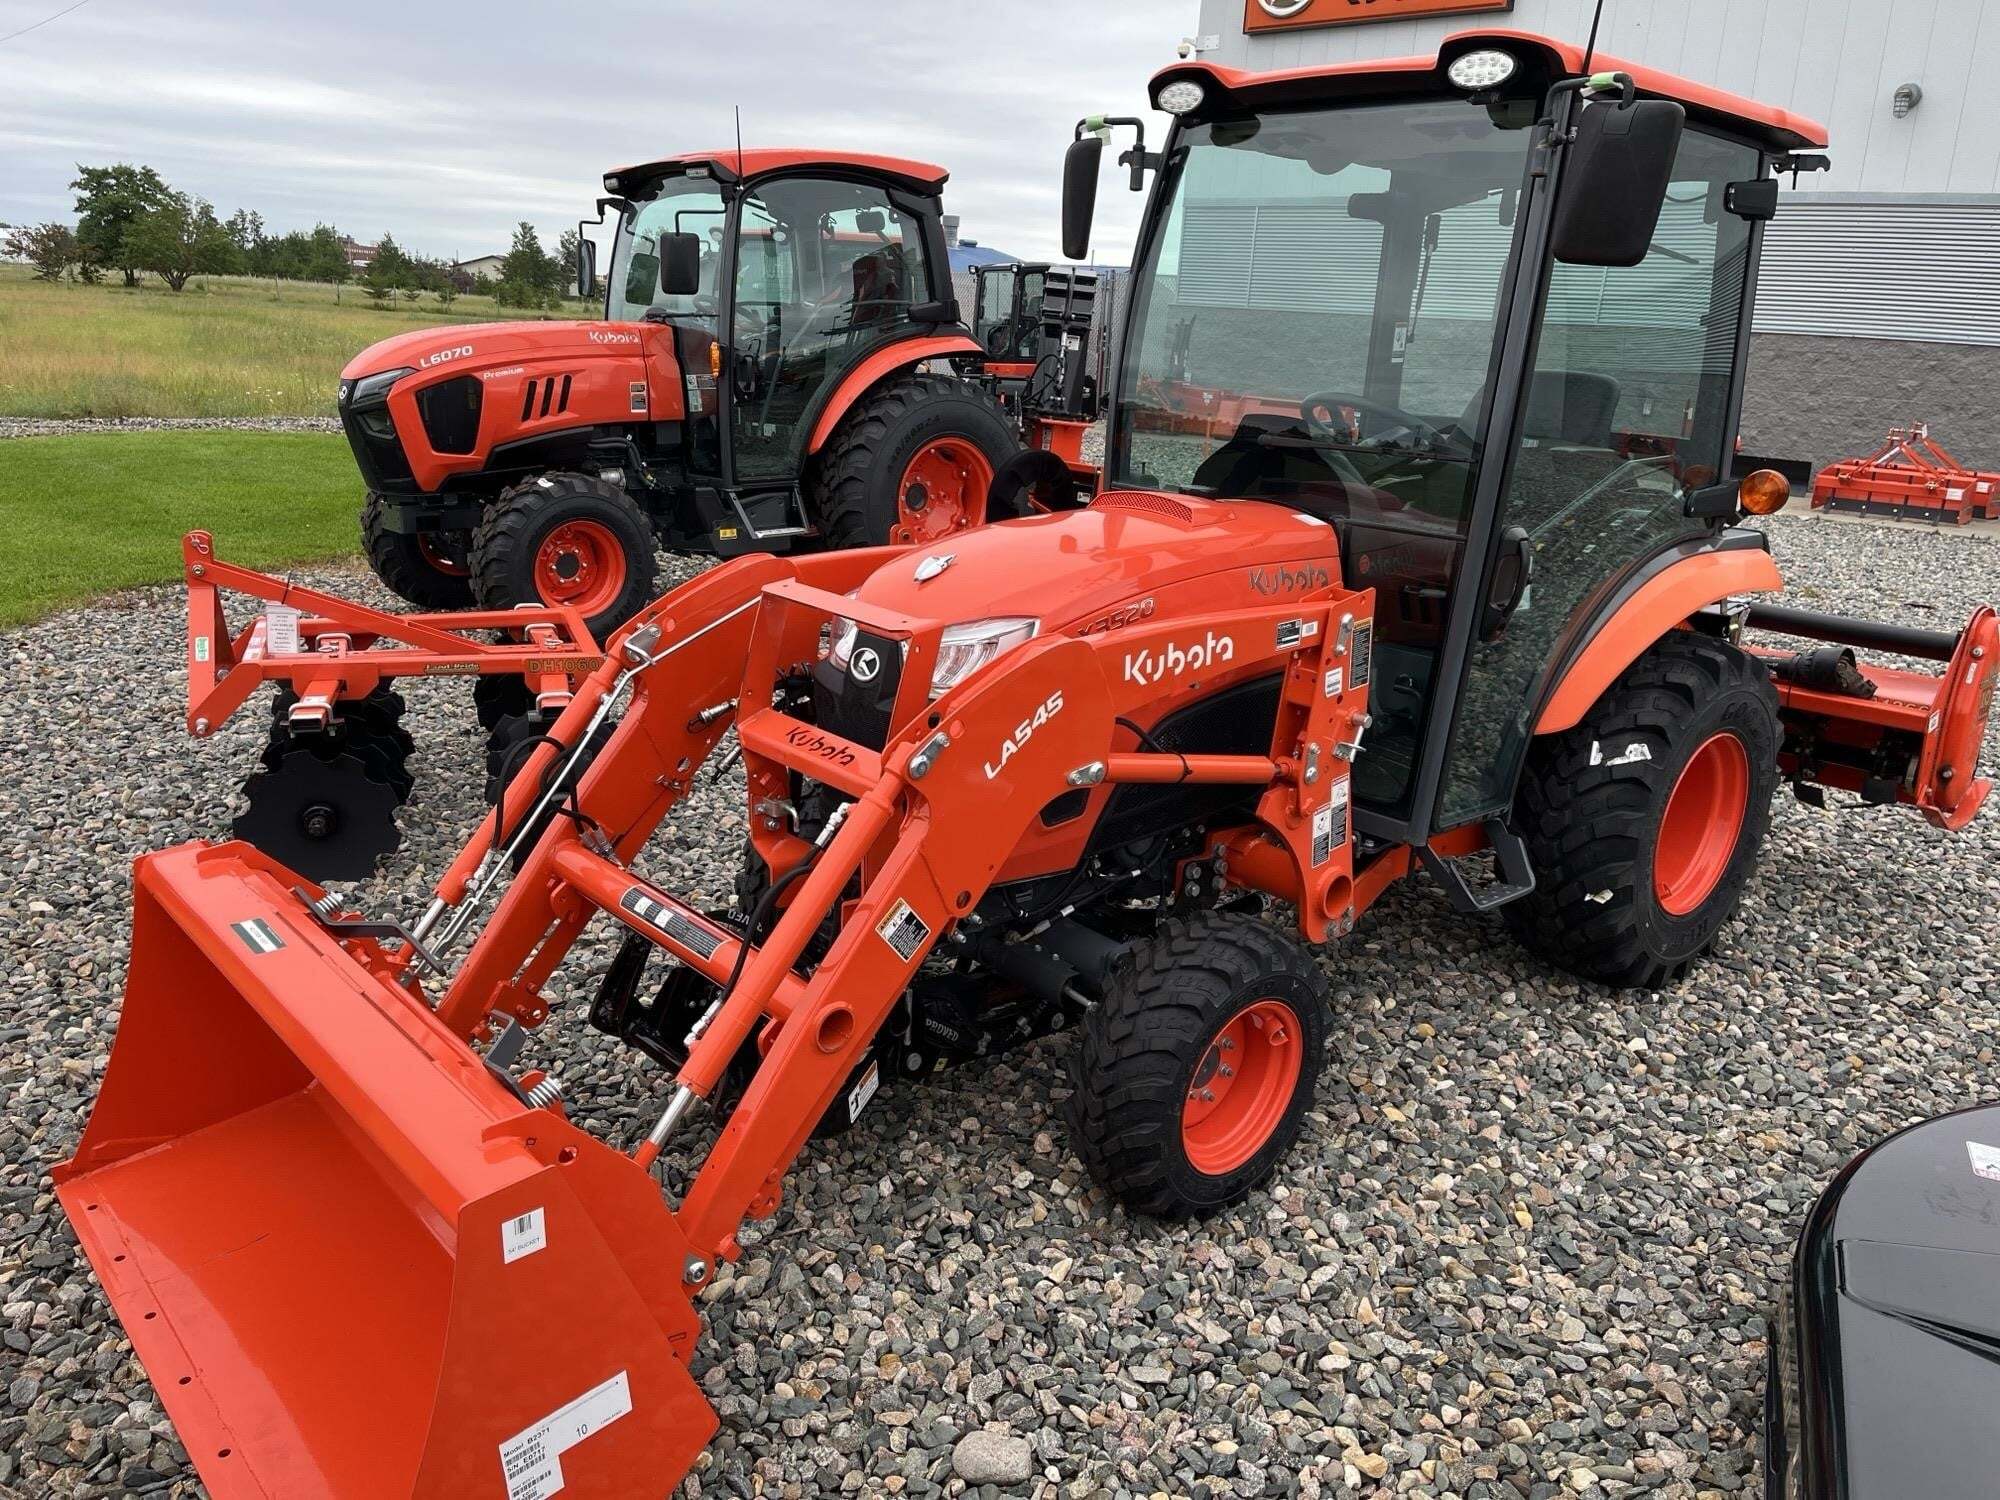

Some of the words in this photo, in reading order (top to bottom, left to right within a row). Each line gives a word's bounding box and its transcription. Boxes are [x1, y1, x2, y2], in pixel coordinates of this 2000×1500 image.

[589, 331, 640, 344] Kubota
[420, 345, 473, 368] L6070
[483, 367, 525, 380] Premium
[1248, 562, 1329, 596] Kubota
[530, 659, 599, 672] DH1060
[1124, 631, 1234, 686] Kubota
[984, 689, 1064, 780] LA545
[785, 726, 856, 766] Kubota
[576, 1423, 588, 1438] 10
[503, 1442, 524, 1458] Model
